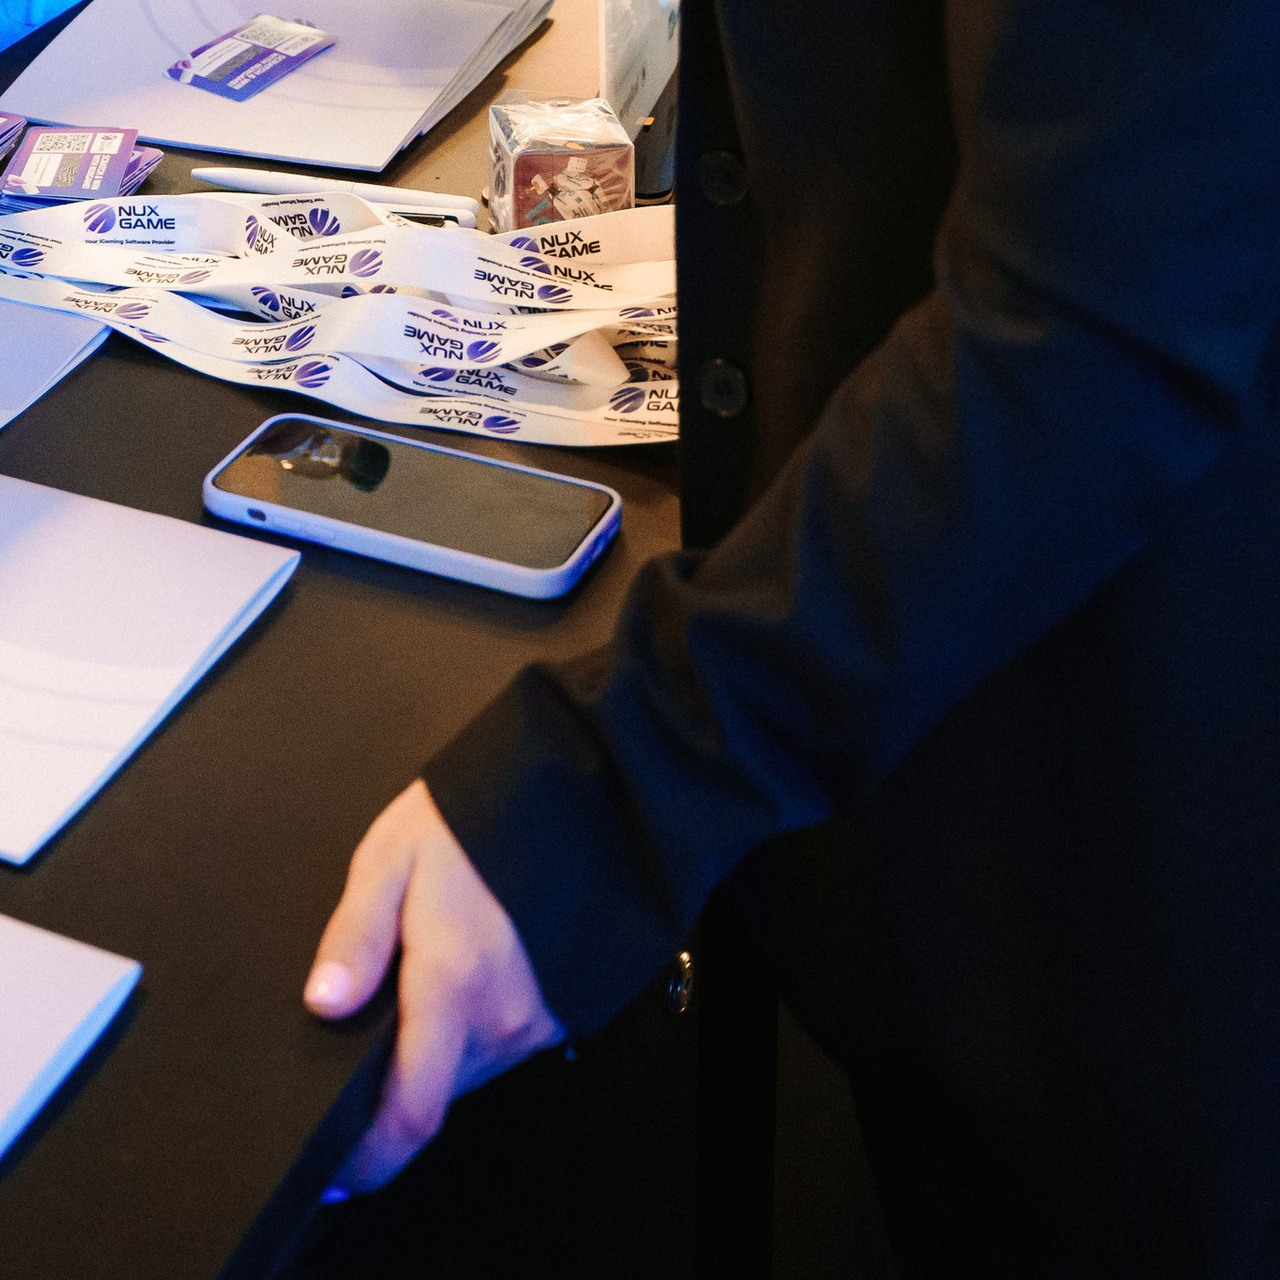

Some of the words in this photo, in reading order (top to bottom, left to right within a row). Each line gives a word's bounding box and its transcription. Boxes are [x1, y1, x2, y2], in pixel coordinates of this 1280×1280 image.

[118, 205, 159, 217] NUX
[119, 218, 176, 230] GAME
[540, 230, 584, 250] NUX
[292, 254, 348, 268] GAME
[304, 264, 346, 276] NUX
[553, 265, 596, 283] NUX
[473, 269, 535, 291] GAME
[490, 284, 535, 299] NUX
[280, 294, 317, 312] NUX
[231, 334, 287, 346] GAME
[403, 325, 464, 350] GAME
[244, 343, 283, 354] NUX
[419, 341, 463, 361] NUX
[455, 374, 518, 396] GAME
[648, 390, 678, 400] NU
[419, 406, 483, 420] GAME
[434, 414, 480, 427] NUX
